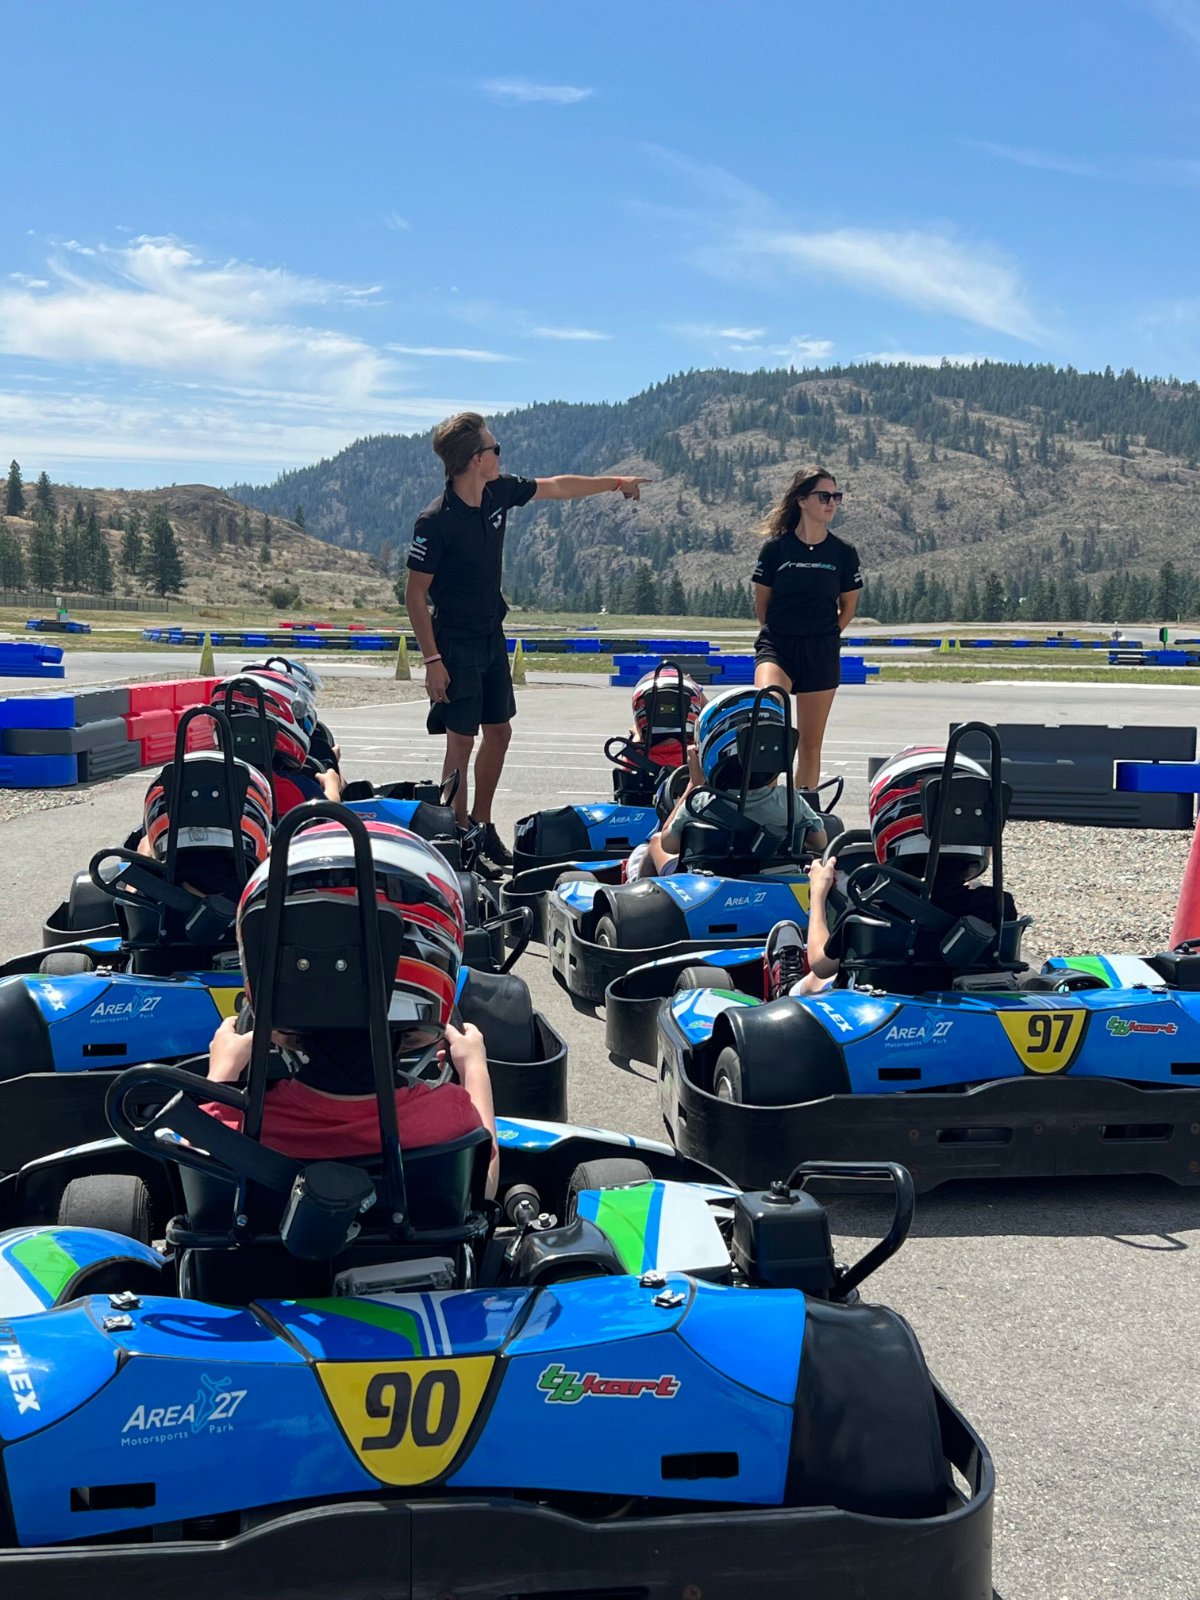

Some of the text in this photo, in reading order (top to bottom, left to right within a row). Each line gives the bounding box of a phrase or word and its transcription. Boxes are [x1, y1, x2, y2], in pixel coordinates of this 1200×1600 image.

[609, 812, 645, 824] AREA 27
[724, 896, 750, 907] AREA
[753, 892, 767, 902] 27
[91, 996, 162, 1017] AREA 27
[885, 1021, 954, 1041] AREA 27
[932, 1037, 948, 1045] Park
[1026, 1014, 1075, 1054] 97
[121, 1390, 248, 1433] AREA 27
[361, 1369, 461, 1451] 90
[121, 1422, 234, 1447] Motorsports Park
